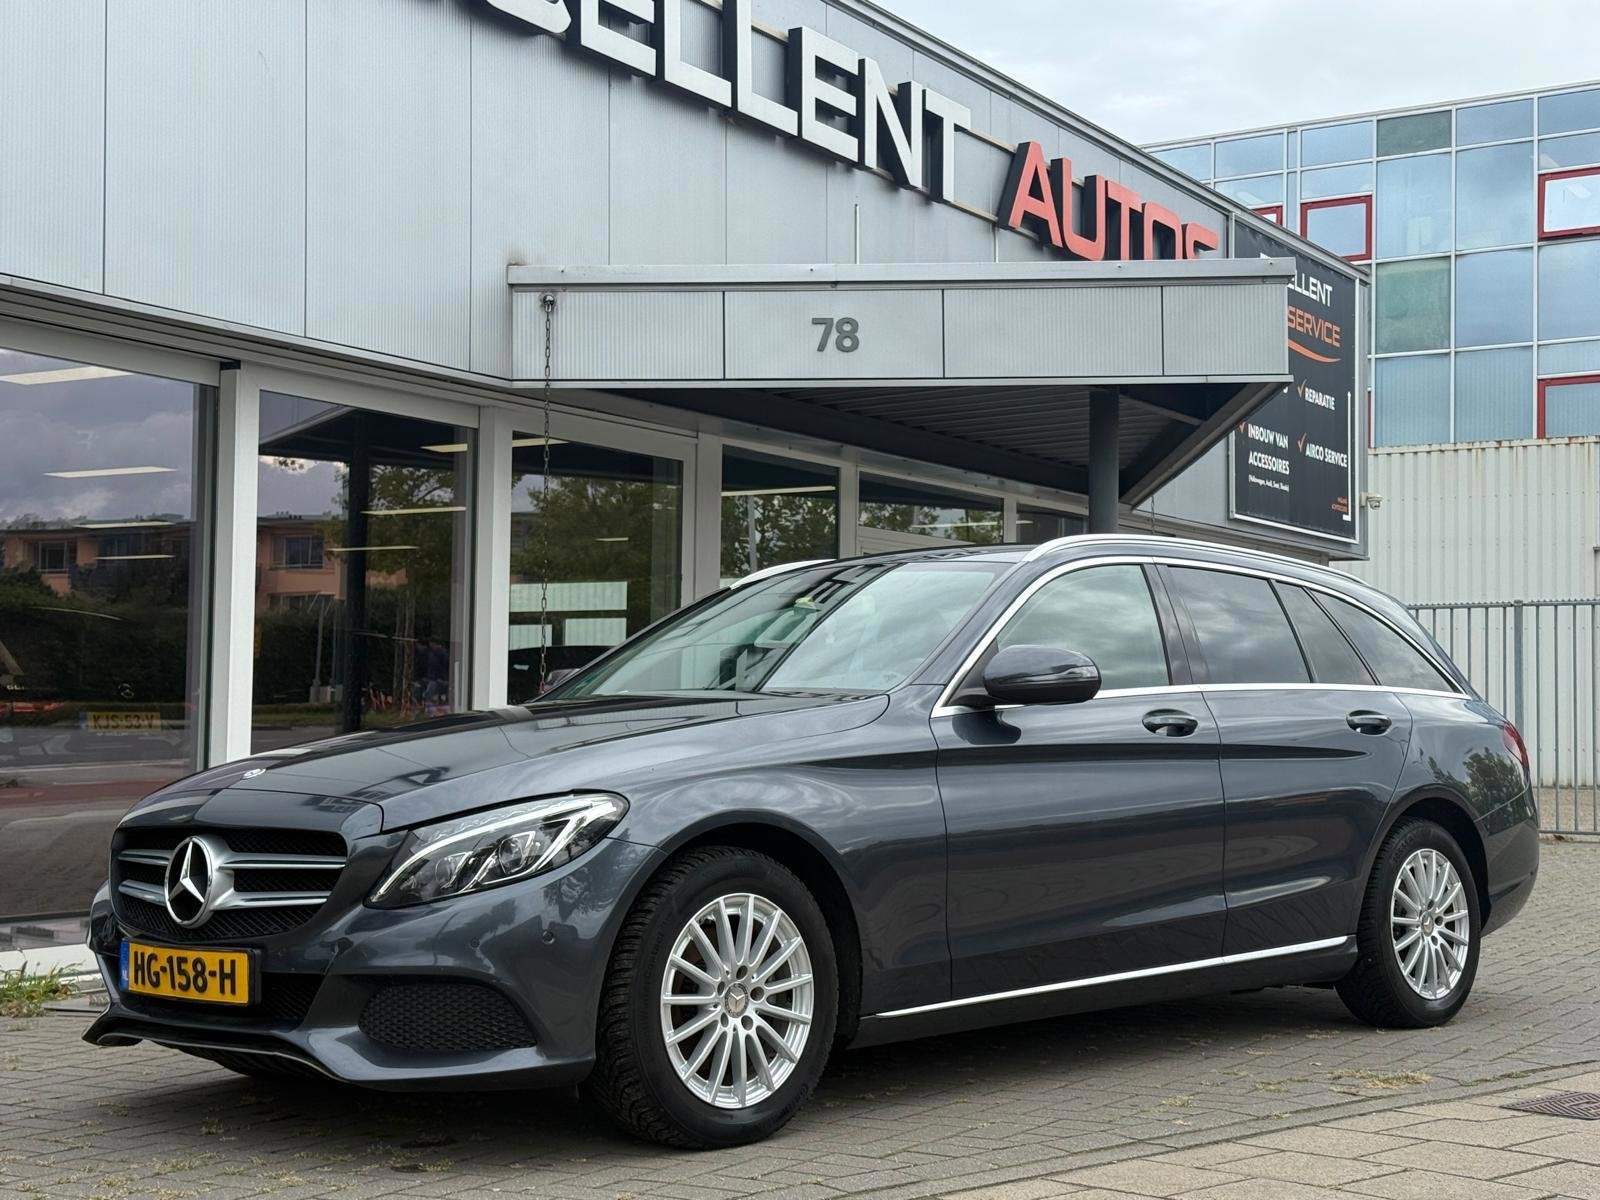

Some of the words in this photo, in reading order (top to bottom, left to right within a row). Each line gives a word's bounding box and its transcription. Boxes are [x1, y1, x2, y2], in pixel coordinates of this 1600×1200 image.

[486, 0, 971, 201] ELLENT
[812, 317, 860, 353] 78
[1288, 305, 1341, 348] SERVICE
[1305, 387, 1335, 411] REPARATIE
[1248, 423, 1274, 446] INBOUW
[1276, 433, 1289, 450] VAN
[1248, 450, 1290, 475] ACCESSOIRES
[1305, 442, 1324, 461] AIRCO
[1324, 447, 1348, 468] SERVICE
[133, 951, 236, 996] HG-158-H
